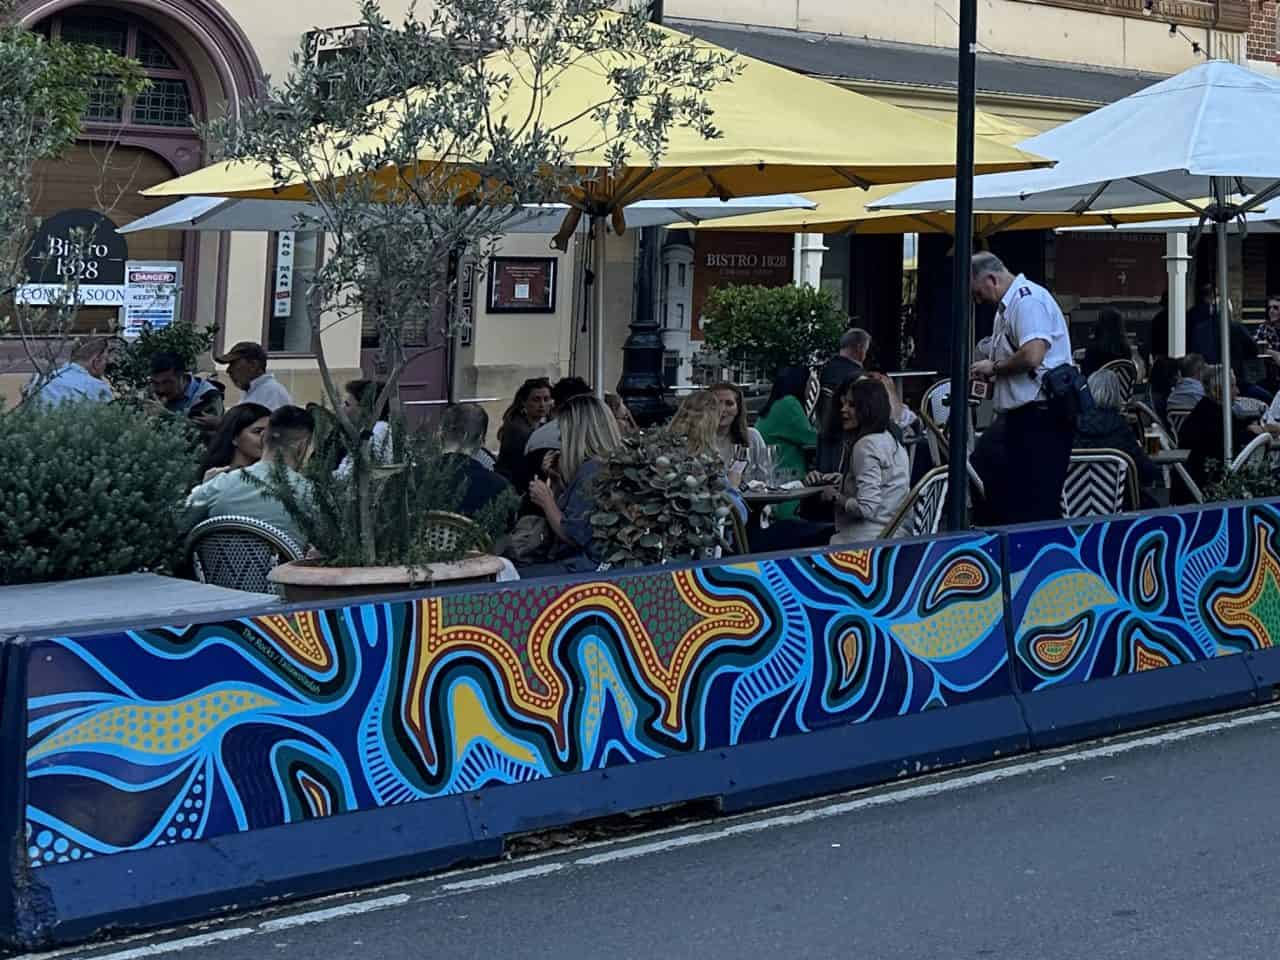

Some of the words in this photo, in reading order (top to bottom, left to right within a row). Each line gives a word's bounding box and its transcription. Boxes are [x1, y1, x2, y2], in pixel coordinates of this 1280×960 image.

[48, 235, 109, 258] Bisro
[706, 253, 758, 267] BISTRO
[762, 254, 787, 267] 1828
[135, 272, 170, 282] DANGER
[86, 288, 126, 302] SOON
